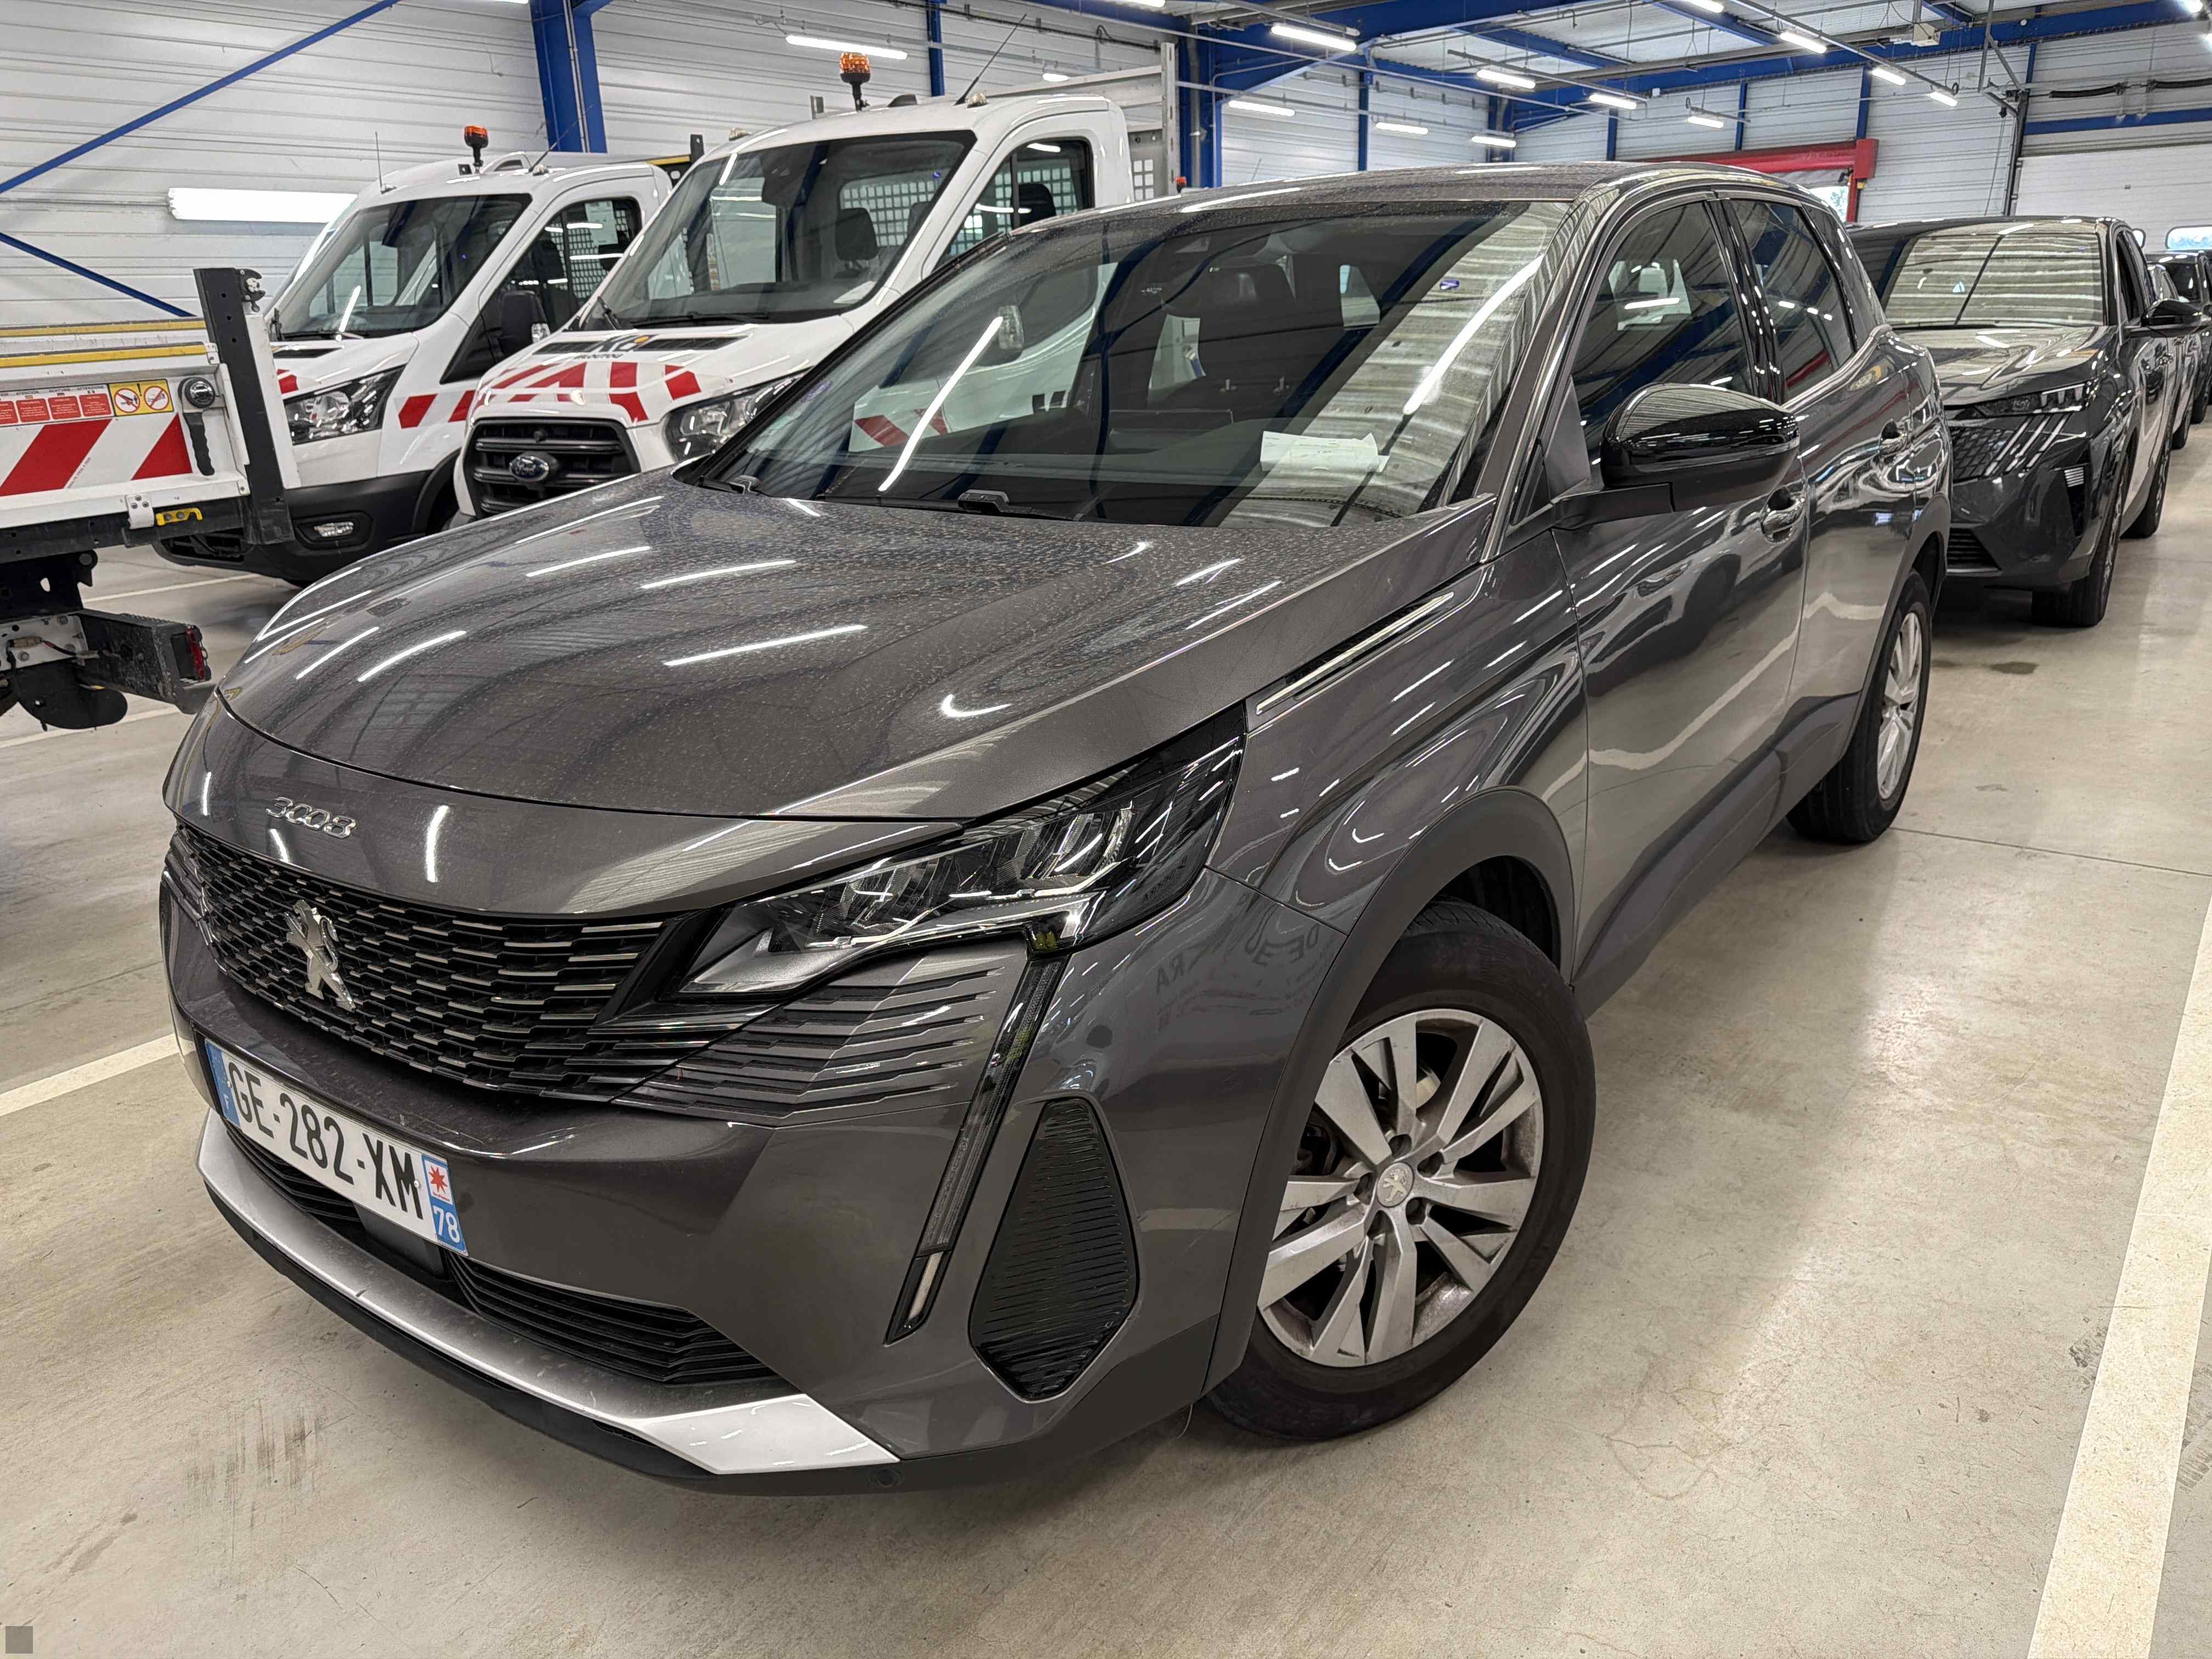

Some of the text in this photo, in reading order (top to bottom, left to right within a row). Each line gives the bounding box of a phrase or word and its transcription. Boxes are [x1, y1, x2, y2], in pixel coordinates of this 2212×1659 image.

[266, 796, 357, 839] 3008
[228, 1061, 424, 1221] GE-282-XM
[432, 1205, 461, 1243] 78
